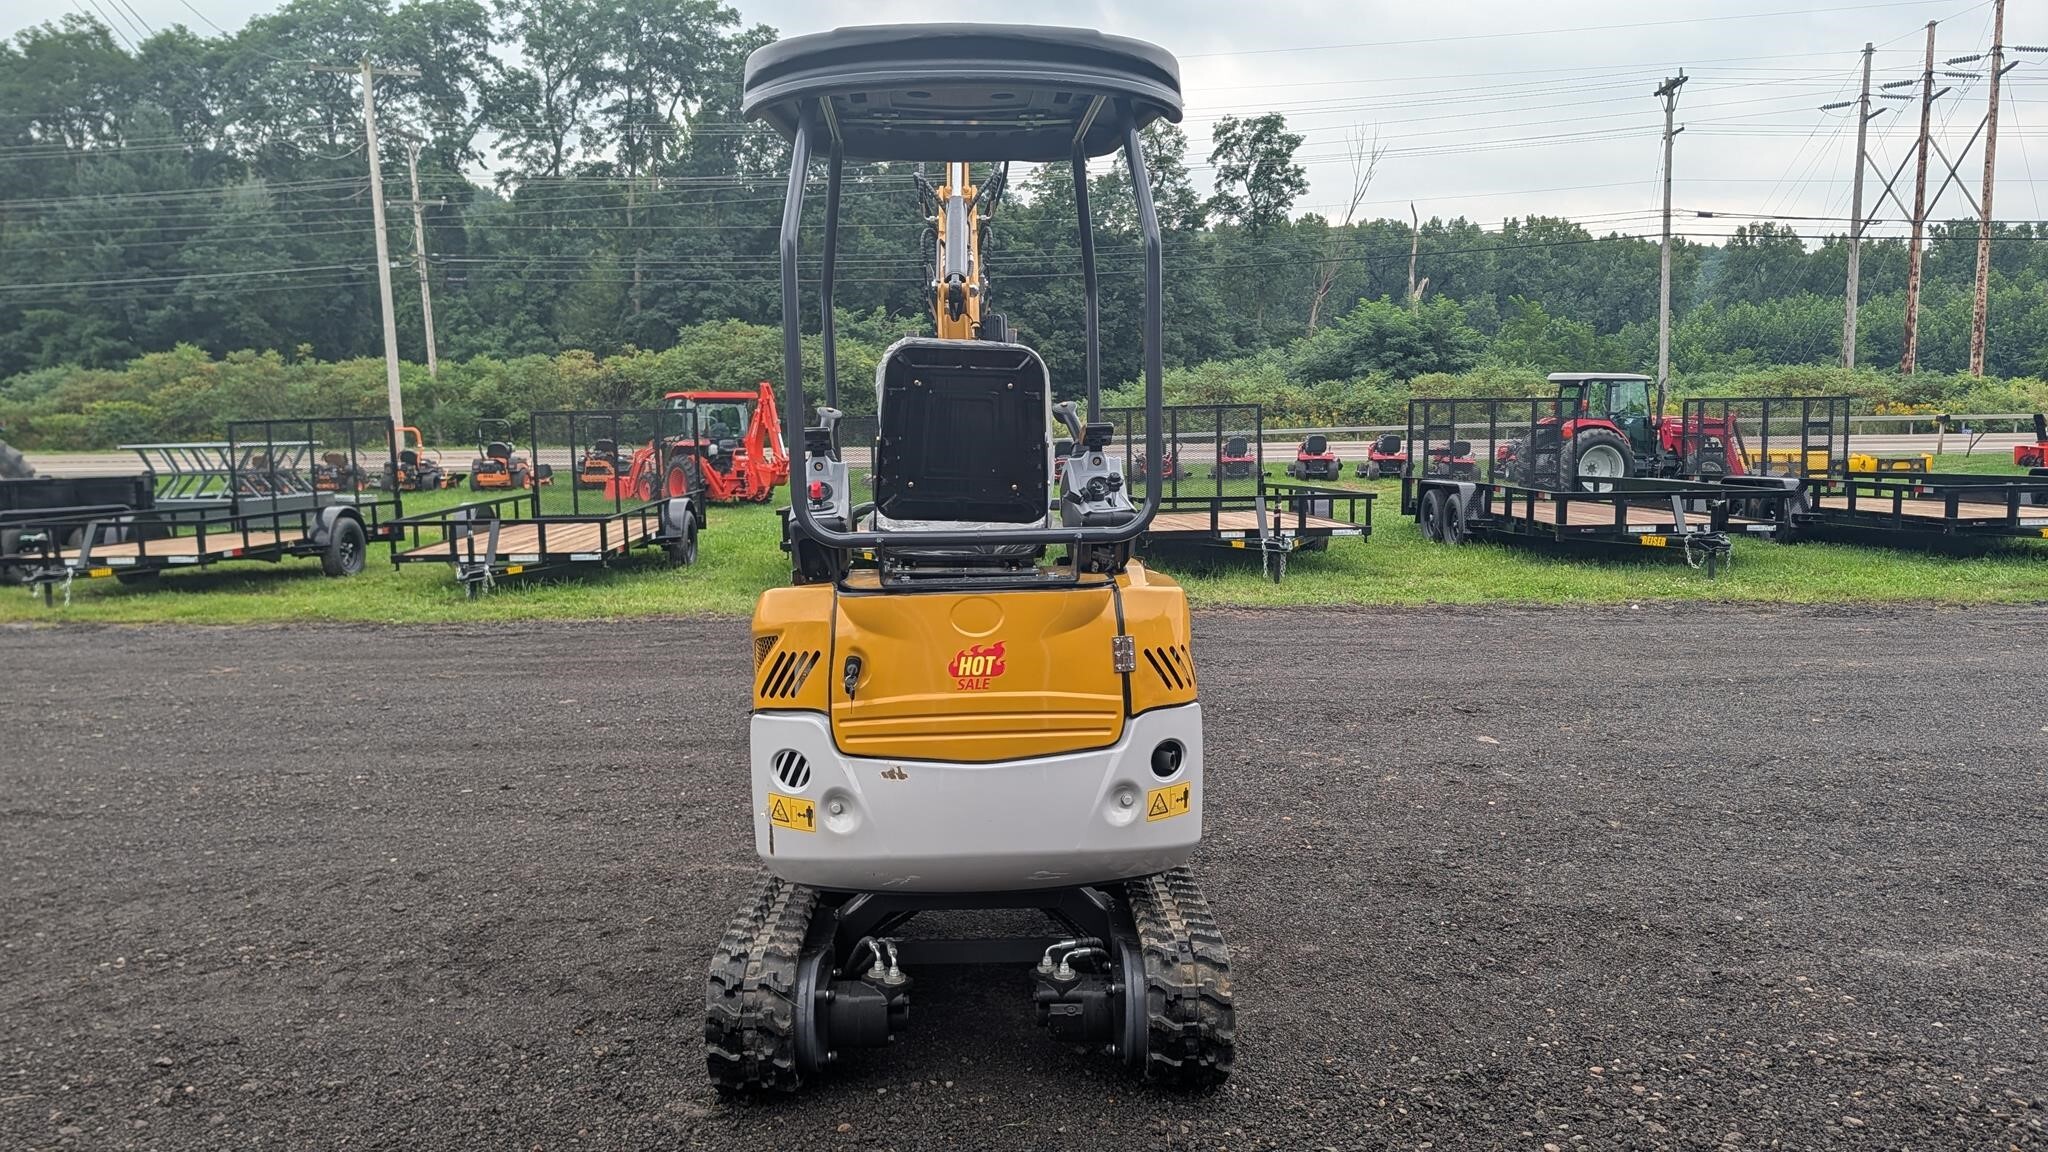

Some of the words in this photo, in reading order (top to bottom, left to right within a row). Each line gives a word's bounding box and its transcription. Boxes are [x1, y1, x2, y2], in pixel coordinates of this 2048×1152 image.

[1641, 535, 1666, 547] REISER
[958, 656, 996, 676] HOT
[957, 678, 991, 690] SALE
